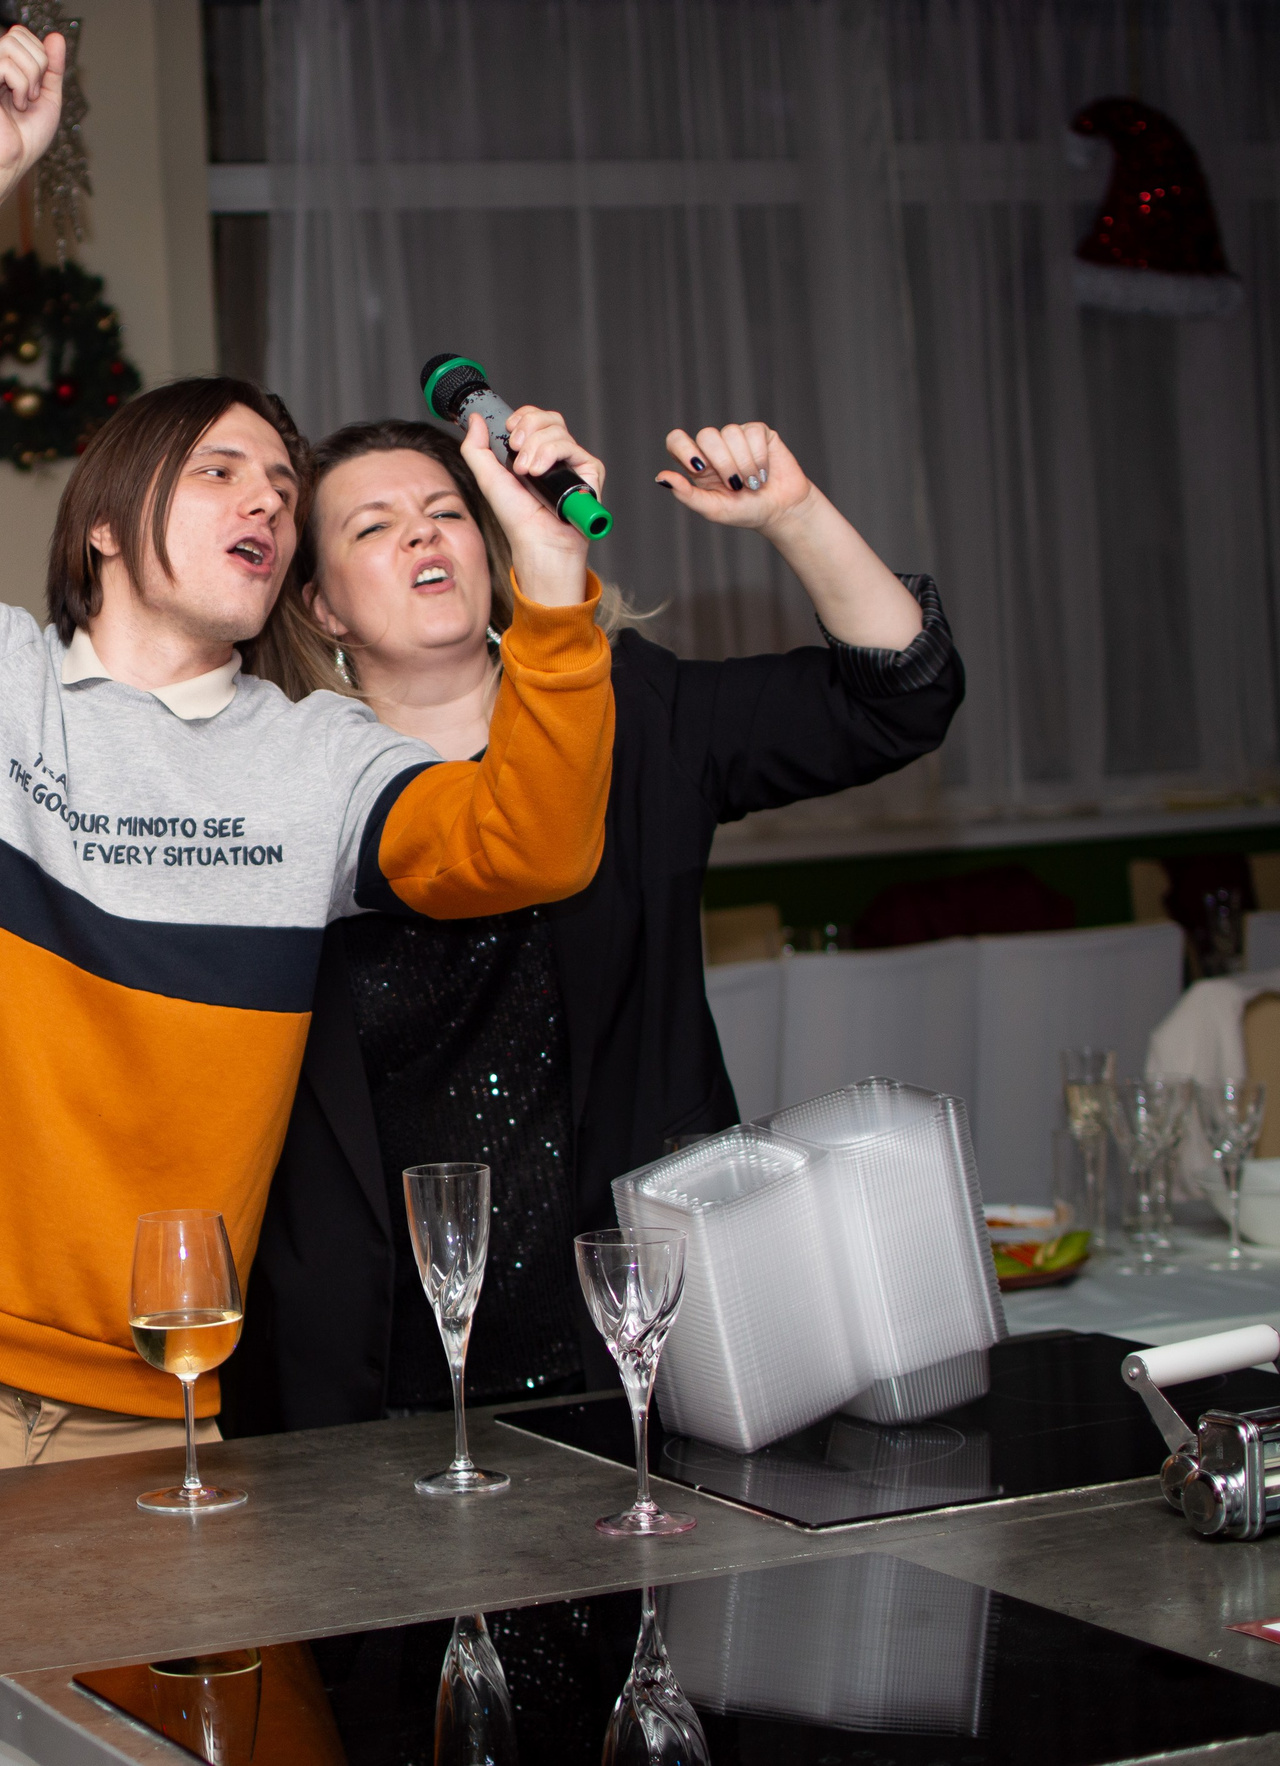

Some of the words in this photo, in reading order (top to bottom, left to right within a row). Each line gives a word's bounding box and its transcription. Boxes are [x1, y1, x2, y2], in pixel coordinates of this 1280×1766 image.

[9, 758, 32, 792] THE
[203, 817, 245, 839] SEE
[82, 842, 157, 866] EVERY
[163, 844, 284, 867] SITUATION
